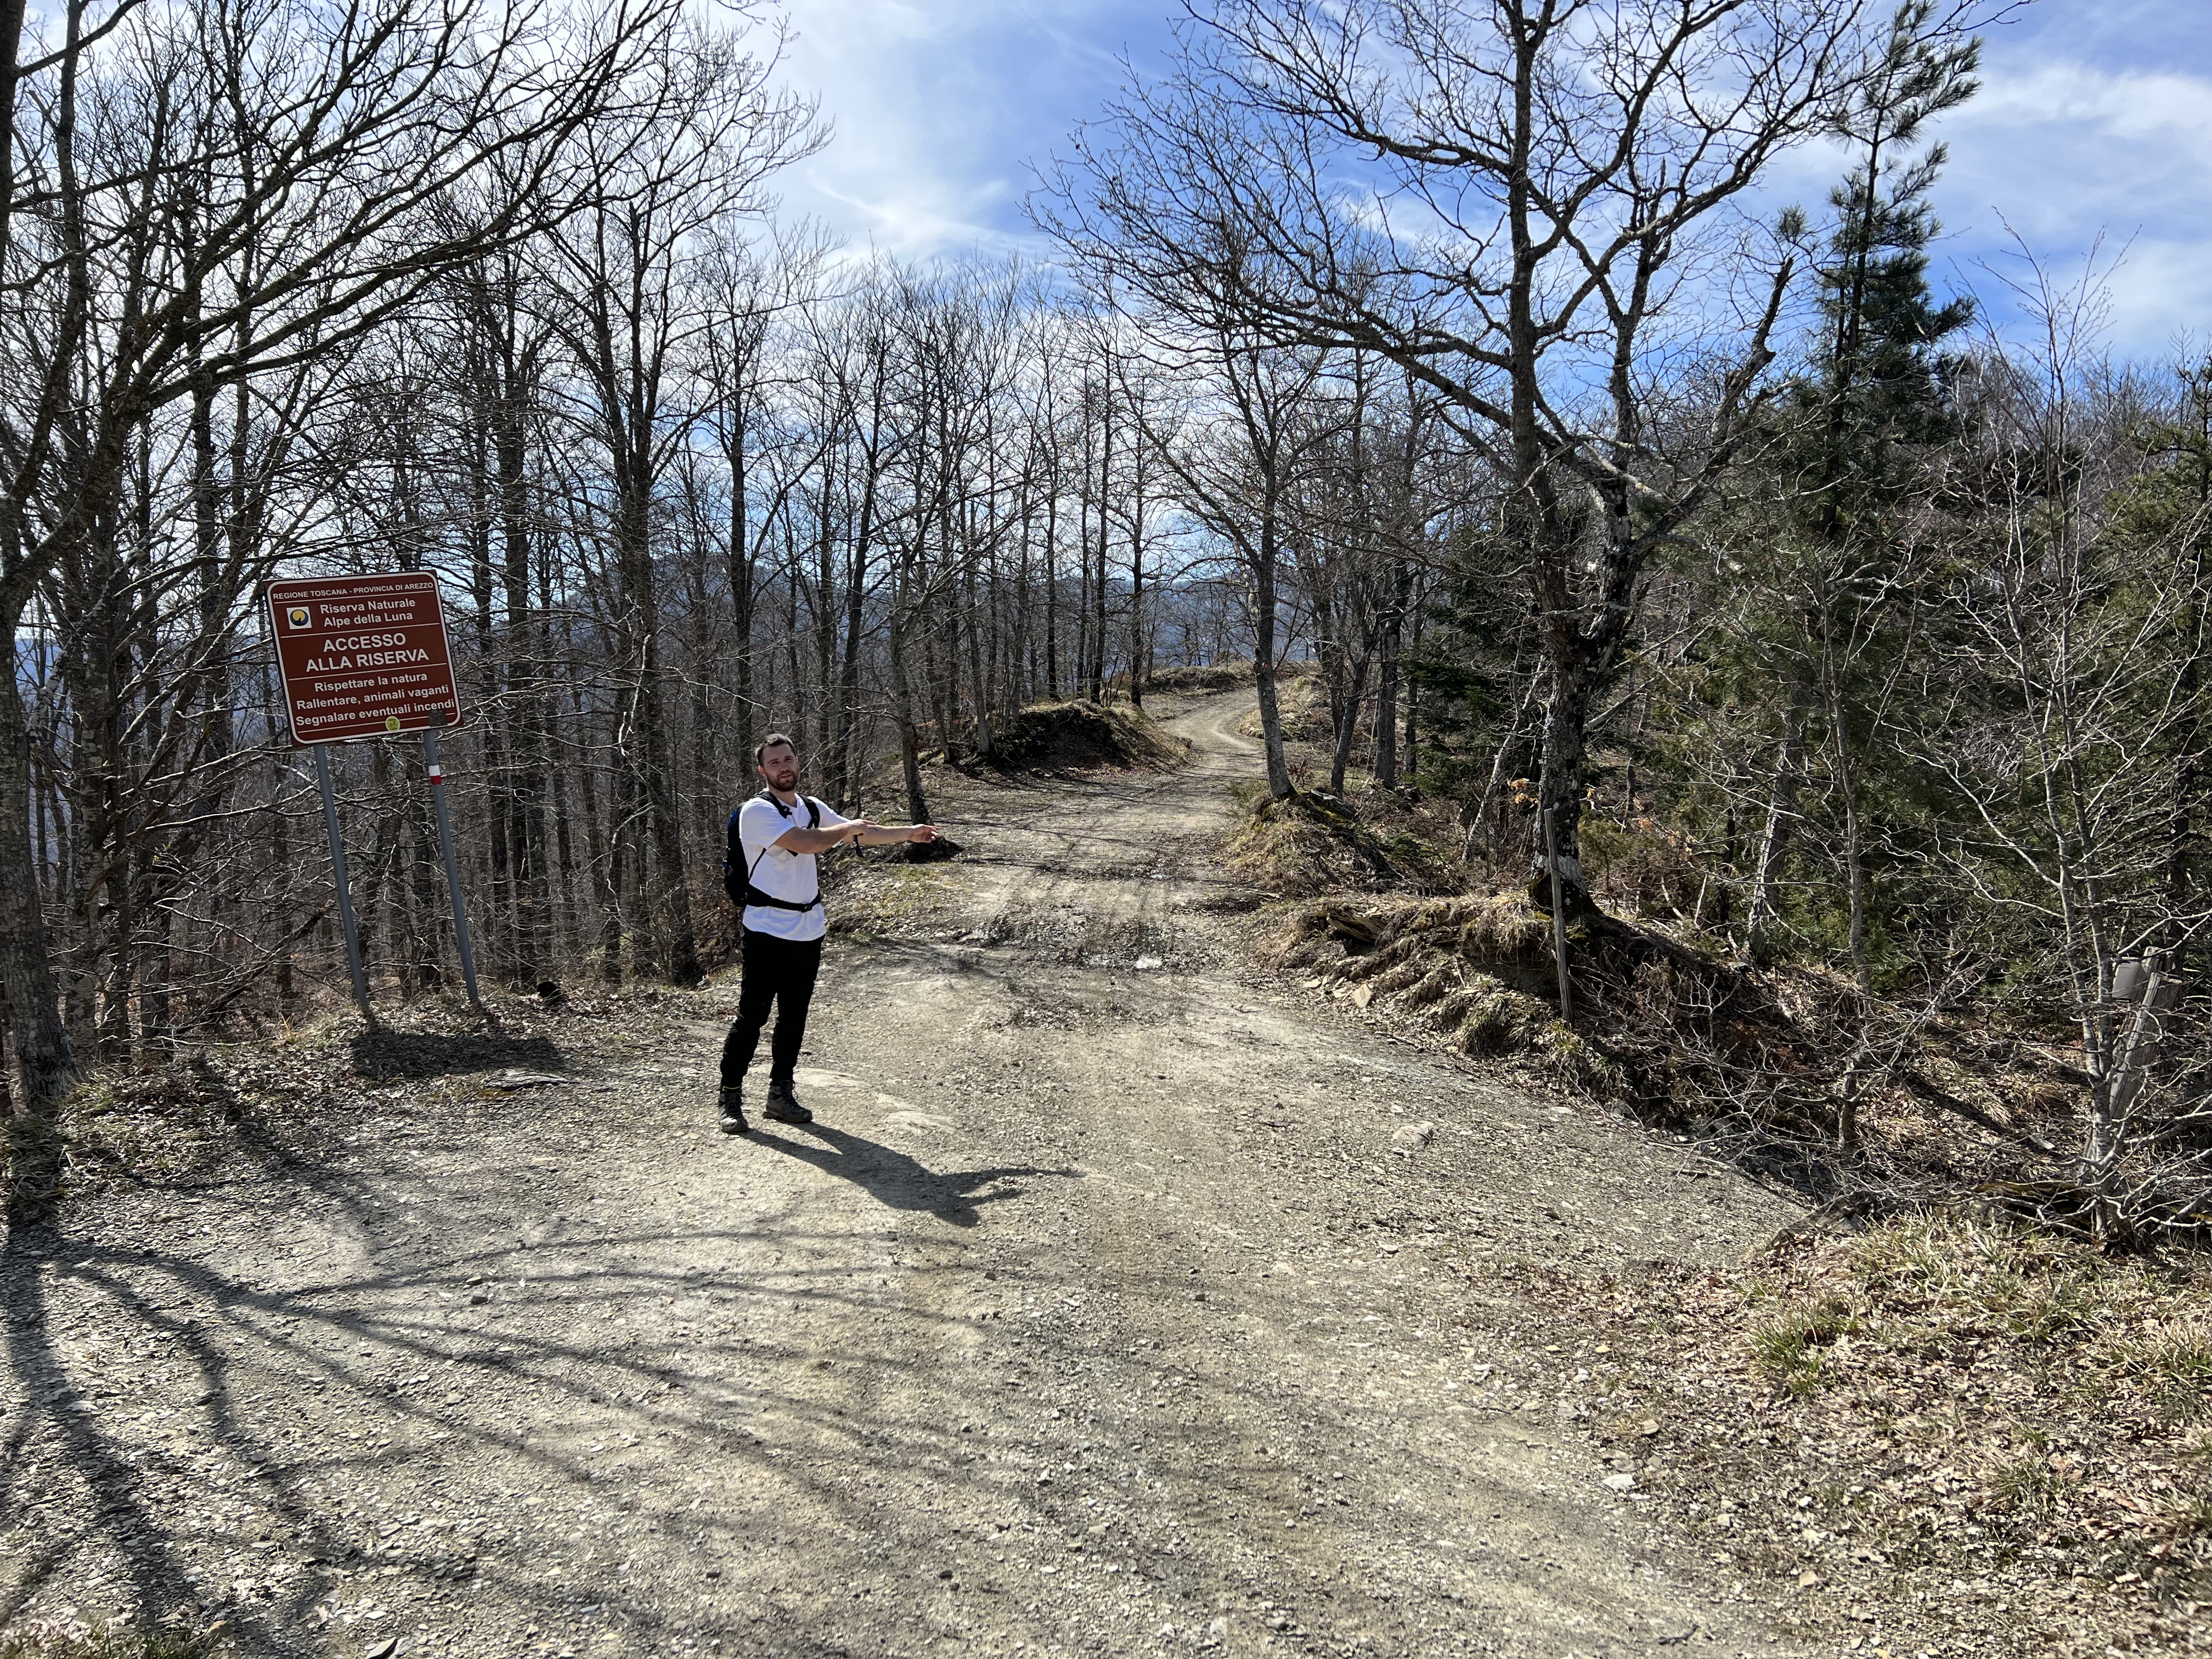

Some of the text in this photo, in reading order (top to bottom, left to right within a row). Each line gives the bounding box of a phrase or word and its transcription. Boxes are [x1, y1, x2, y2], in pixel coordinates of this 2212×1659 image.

[273, 591, 308, 600] REGIONE
[311, 589, 347, 597] TOSCANA
[354, 585, 394, 594] PROVINCIA
[320, 598, 415, 614] Riserva Naturale
[324, 612, 413, 628] Alpe della Luna
[323, 633, 406, 652] ACCESSO
[306, 648, 429, 672] ALLA RISERVA
[314, 673, 427, 692] Rispettare la natura
[297, 685, 449, 710] Rallentare, animali vaganti
[296, 699, 455, 727] Segnalare eventuali incendi
